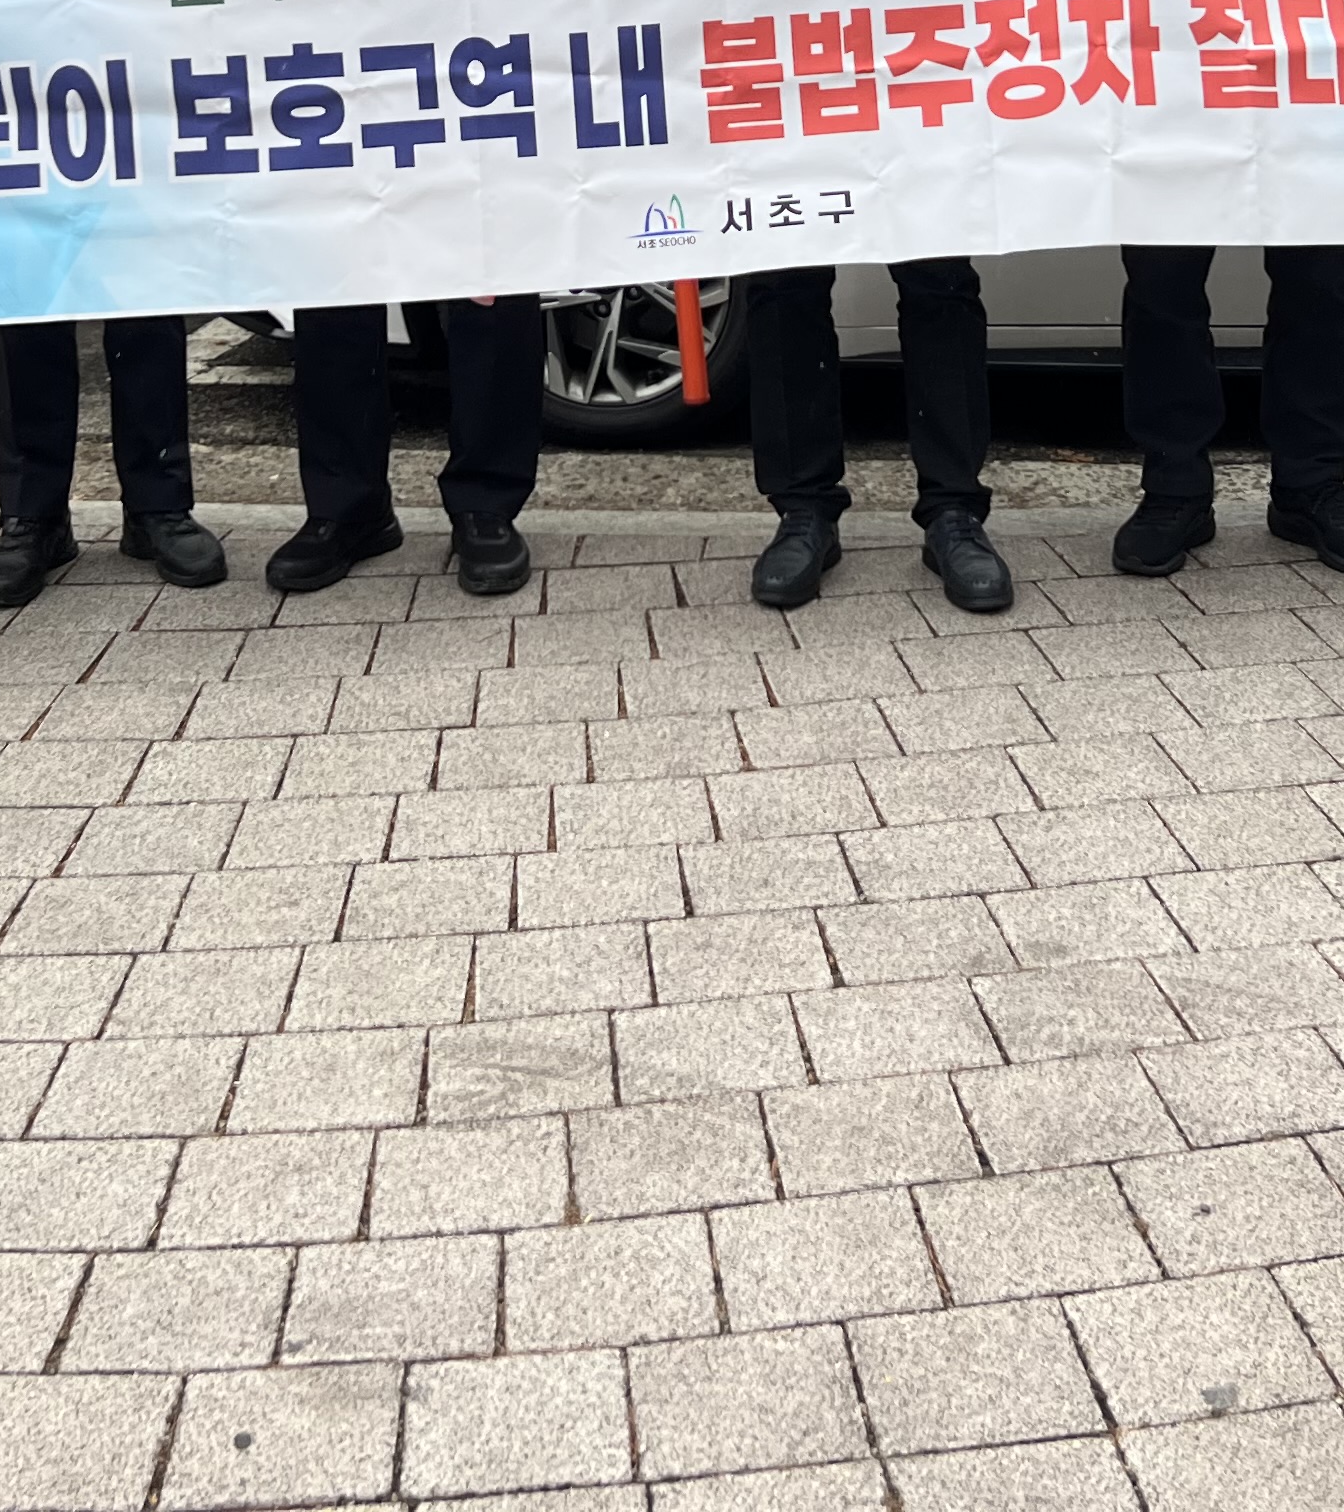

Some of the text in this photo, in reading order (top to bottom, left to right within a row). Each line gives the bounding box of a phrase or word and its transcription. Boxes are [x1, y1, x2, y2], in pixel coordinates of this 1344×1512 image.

[171, 33, 538, 177] 보호구역
[569, 23, 669, 150] 내
[720, 190, 855, 234] 서초구
[659, 235, 696, 247] SEOCHO
